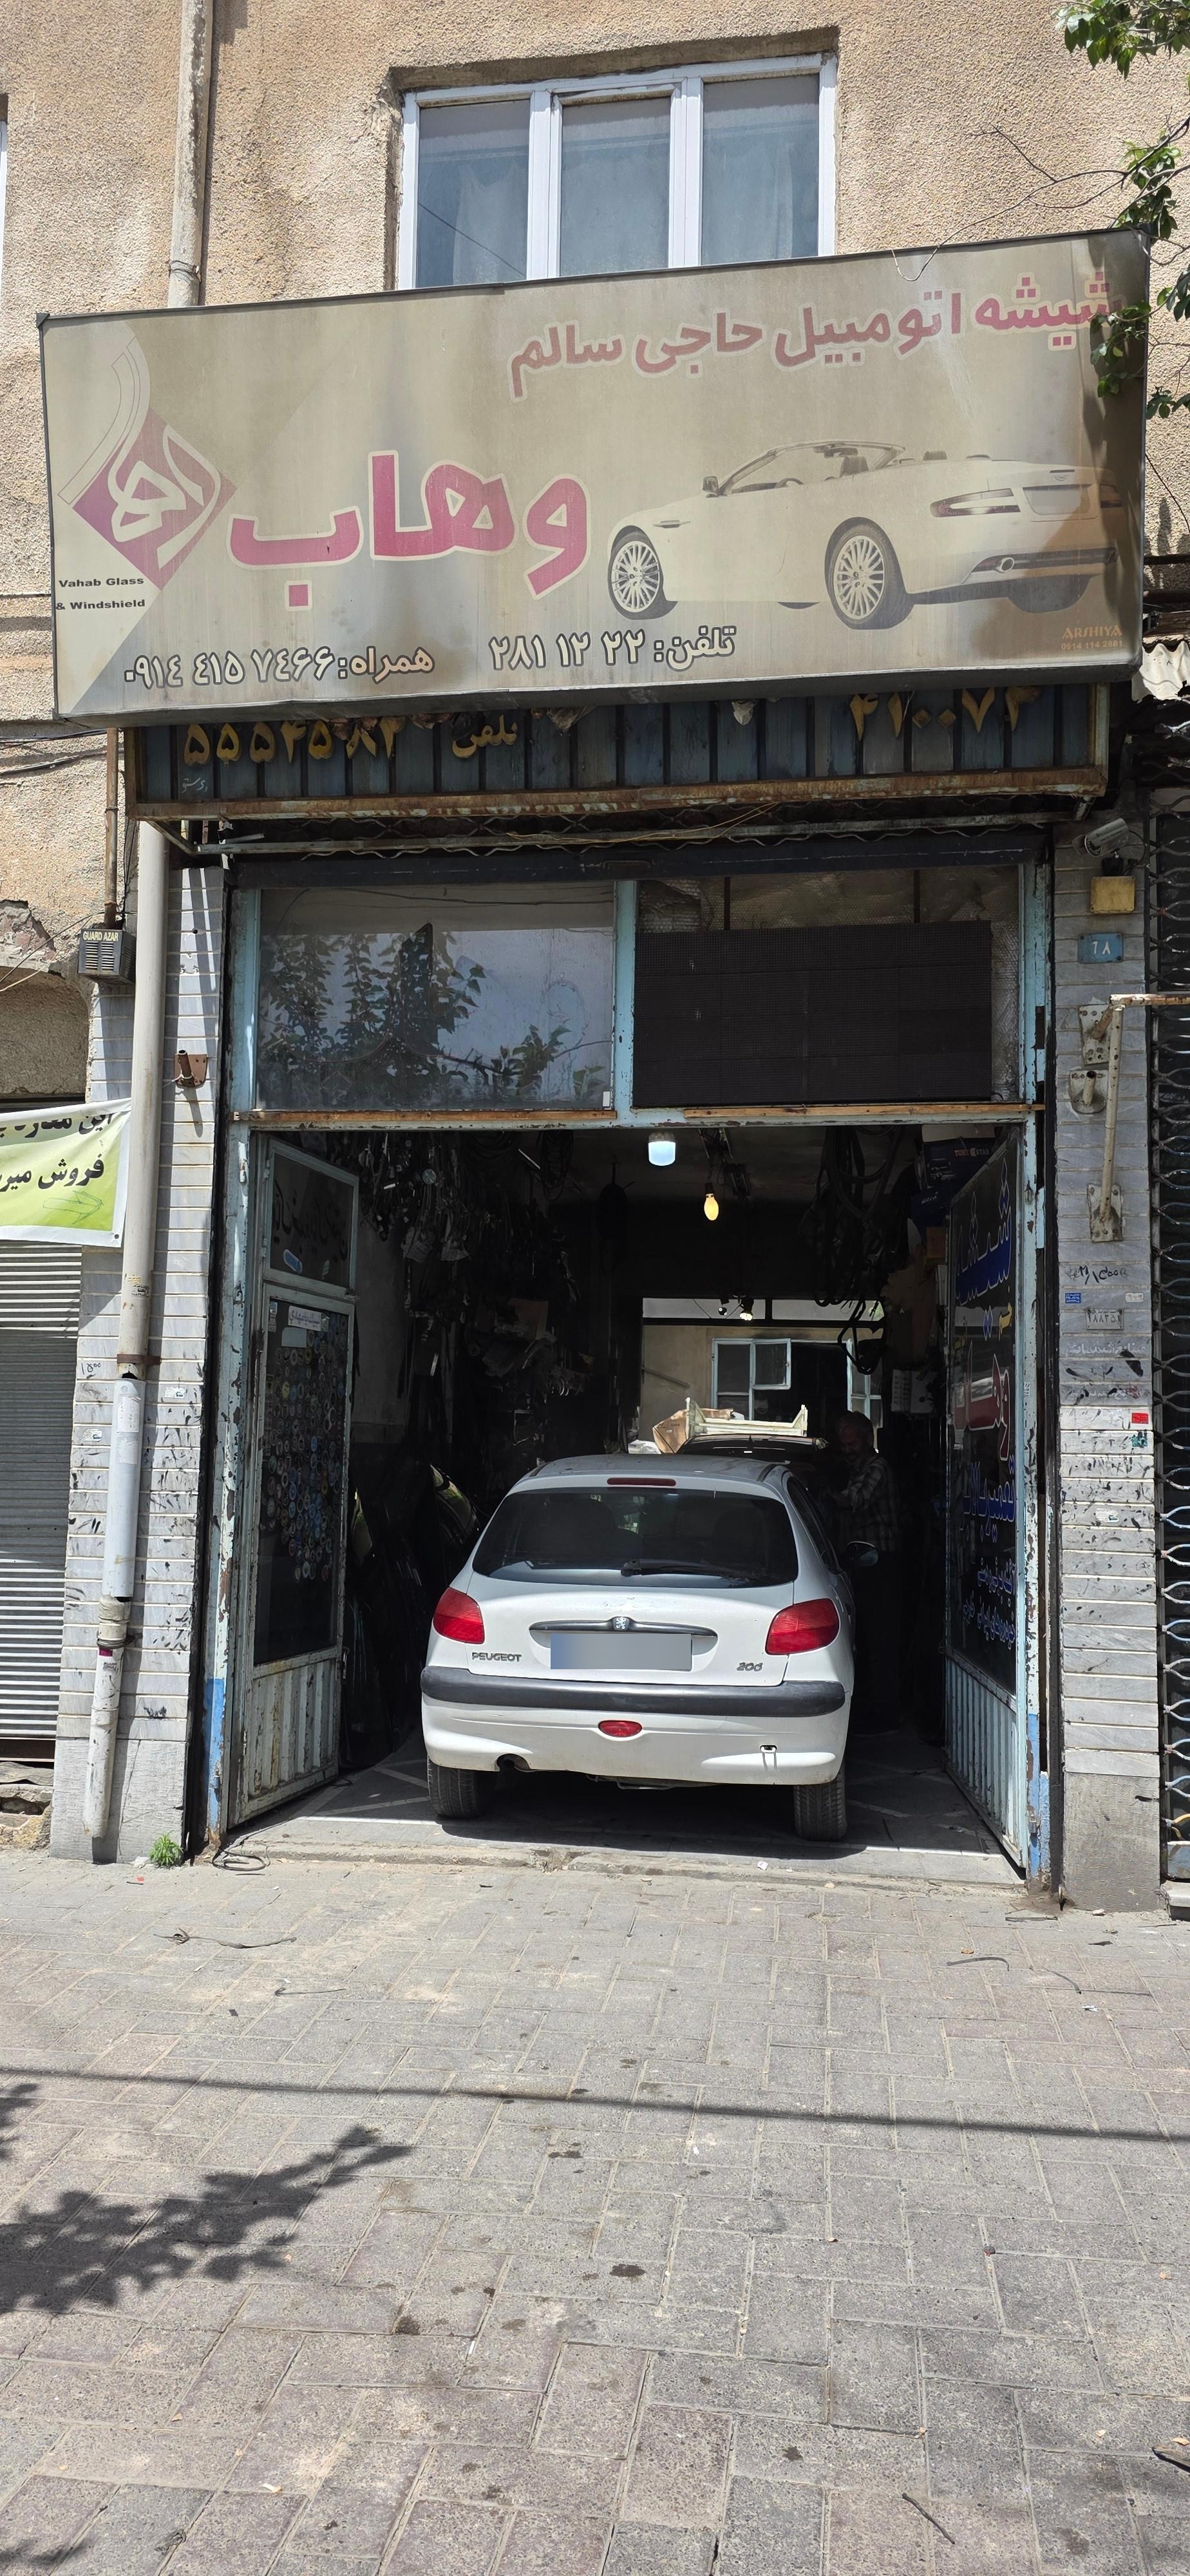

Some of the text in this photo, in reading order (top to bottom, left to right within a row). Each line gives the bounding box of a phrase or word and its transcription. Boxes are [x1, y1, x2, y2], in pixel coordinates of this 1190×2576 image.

[511, 270, 1124, 399] شیشه اتومبیل حاجی سالم
[230, 453, 589, 608] وهاب
[59, 578, 144, 587] Vahab Glass
[55, 599, 146, 611] & Windshield
[1062, 624, 1123, 639] ARSHIYA
[83, 931, 118, 942] GUARD AZAR
[0, 1153, 104, 1193] فروش میر
[471, 1652, 522, 1662] PEUGEOT
[736, 1662, 763, 1672] 206
